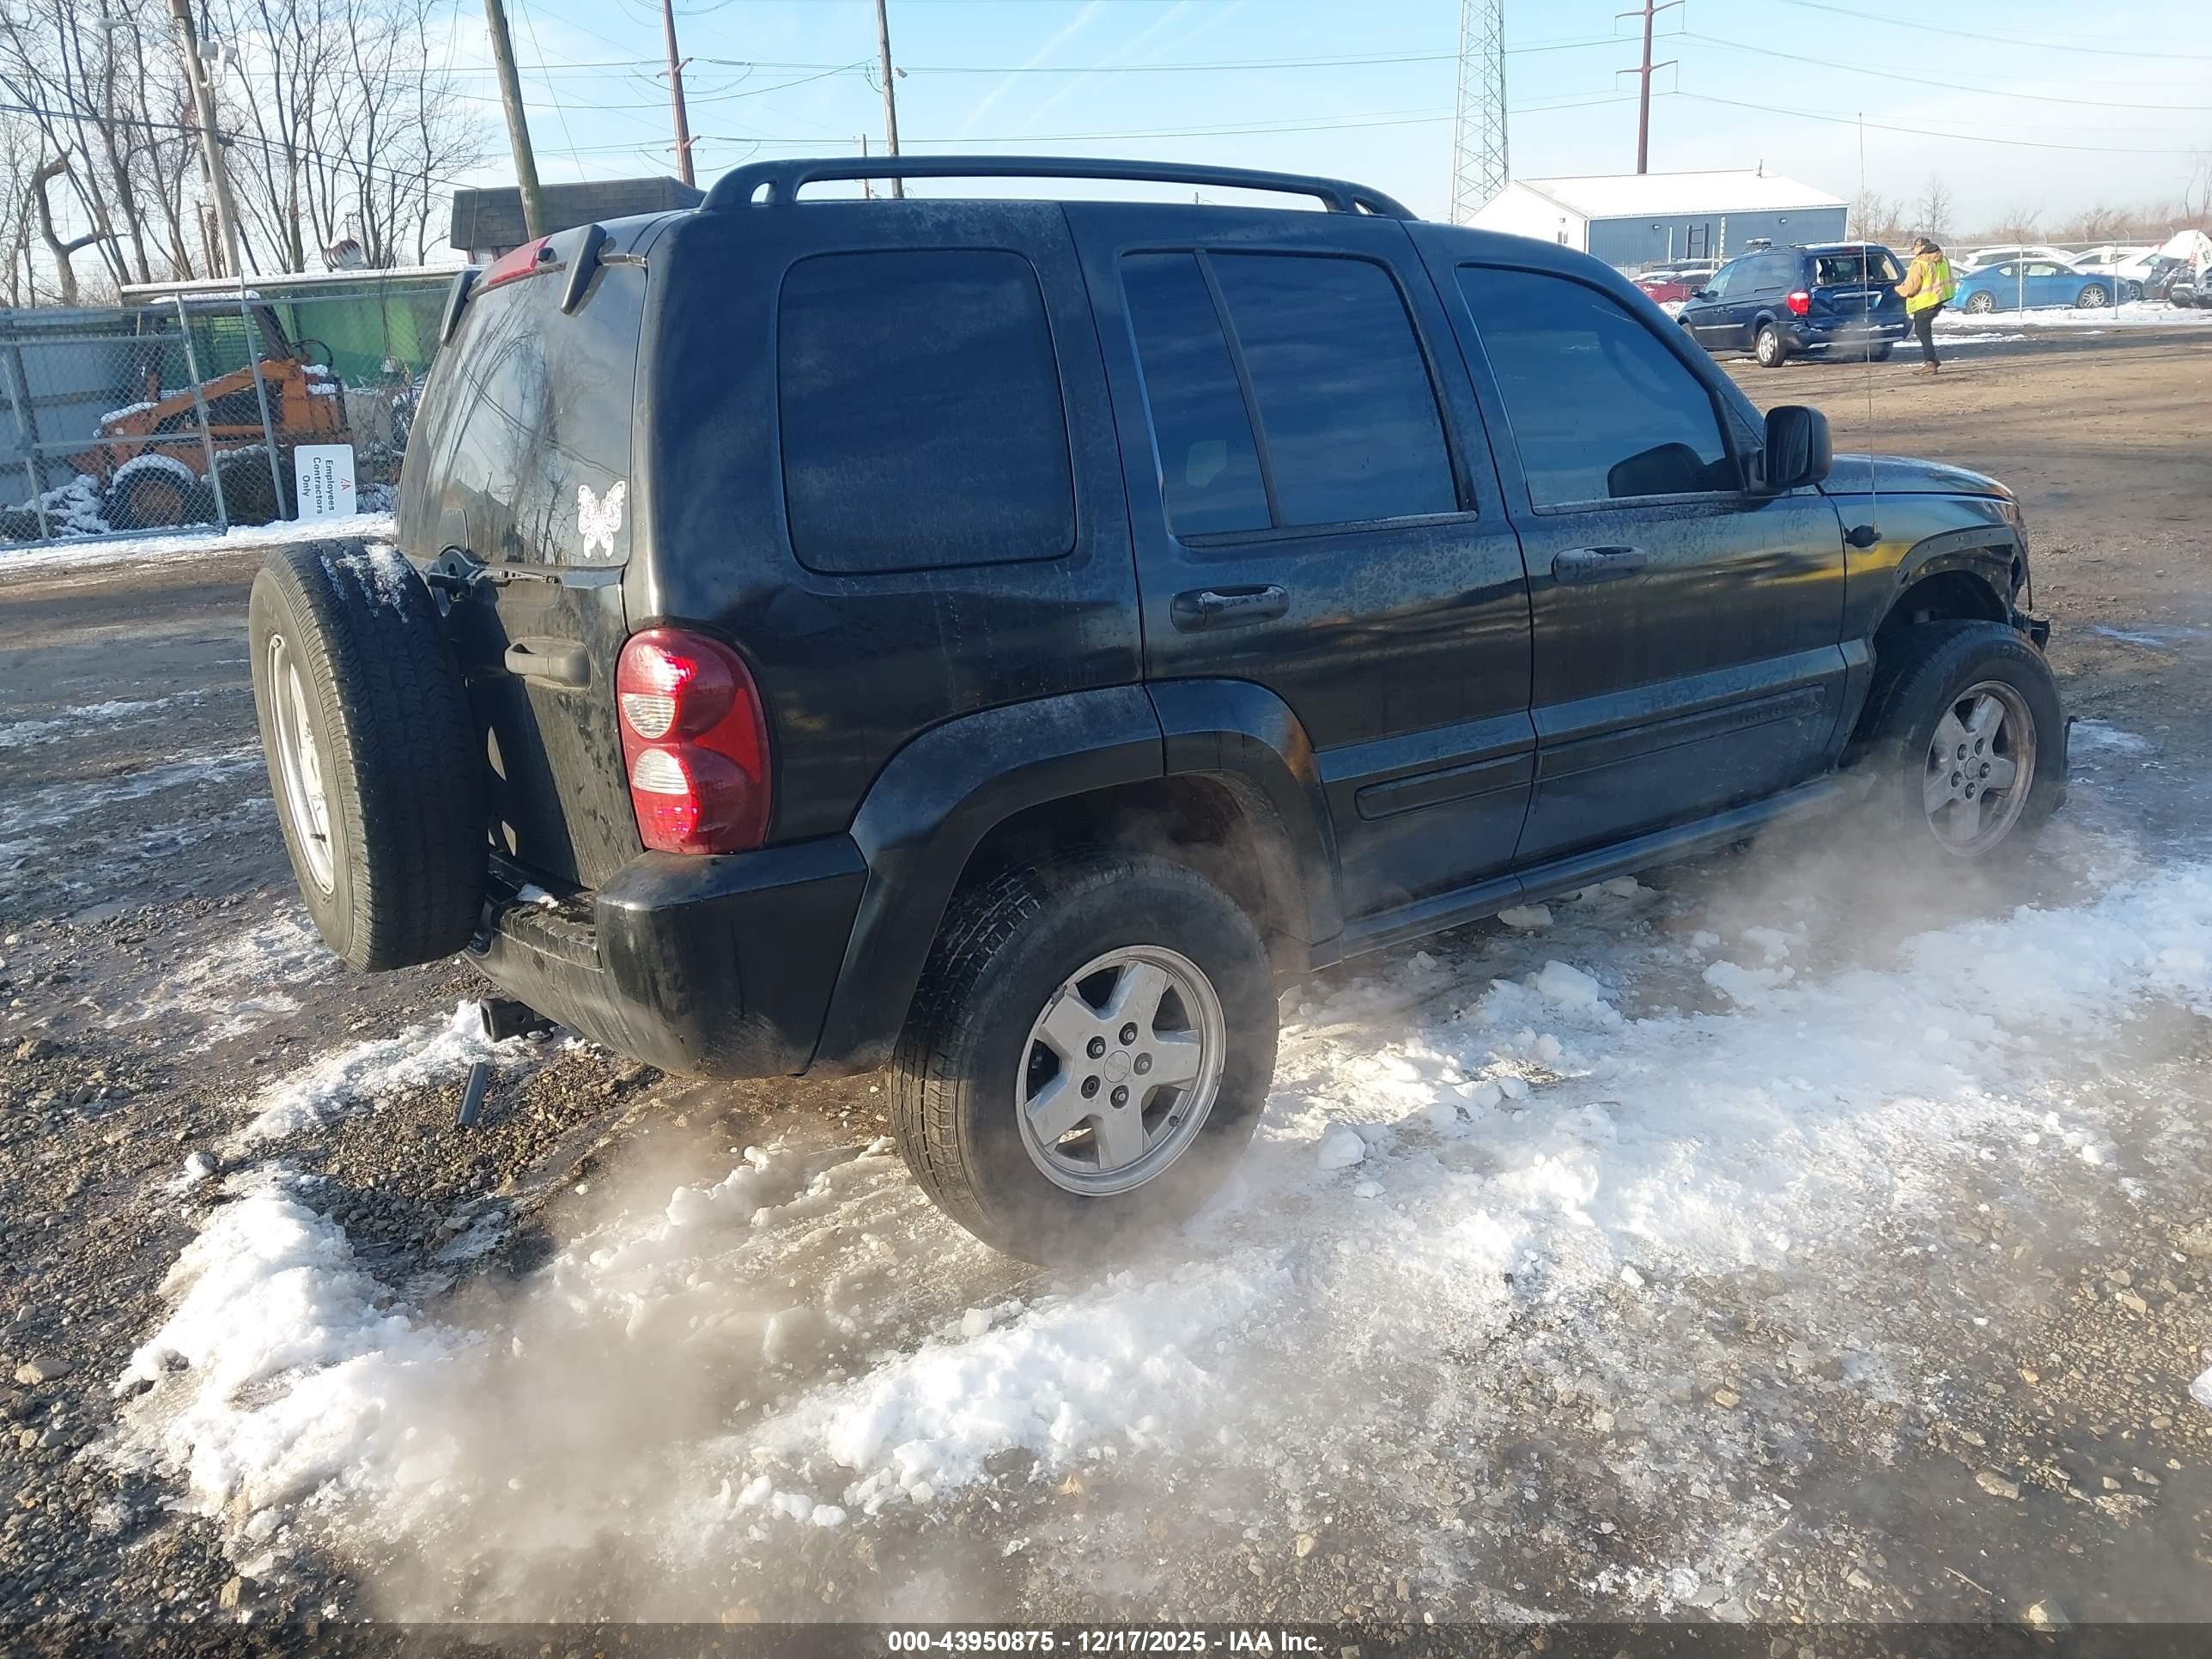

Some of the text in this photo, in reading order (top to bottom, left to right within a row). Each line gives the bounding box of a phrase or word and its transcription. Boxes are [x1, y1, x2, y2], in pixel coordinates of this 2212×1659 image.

[301, 475, 311, 496] Only
[313, 457, 323, 514] Contractors
[325, 459, 335, 511] Employees
